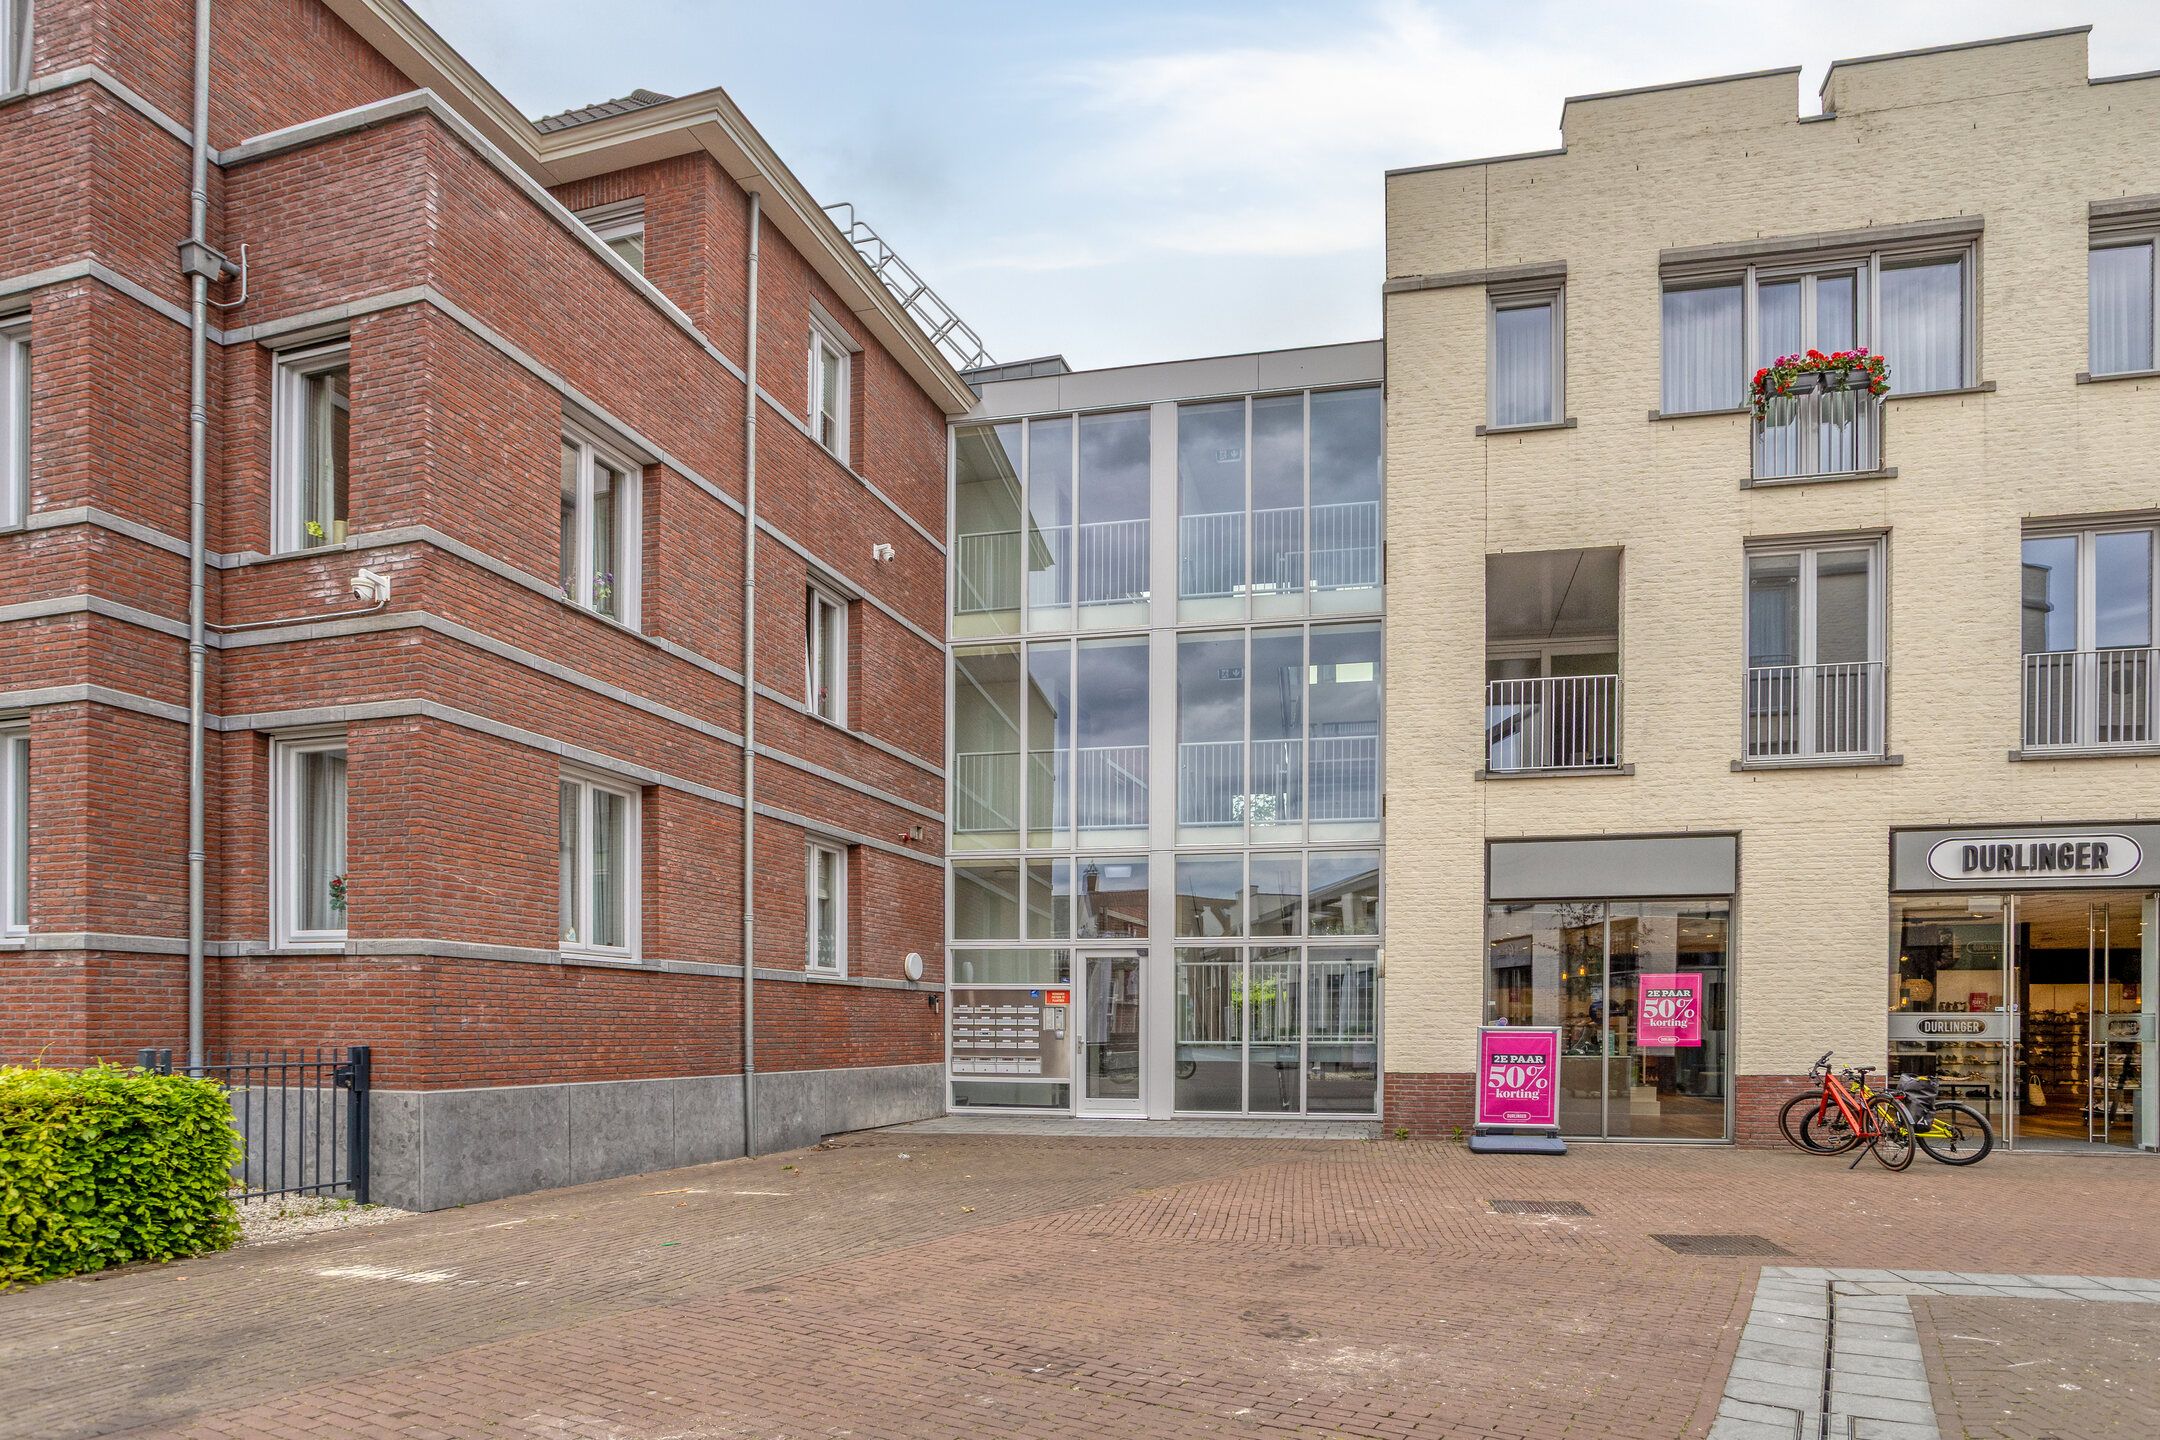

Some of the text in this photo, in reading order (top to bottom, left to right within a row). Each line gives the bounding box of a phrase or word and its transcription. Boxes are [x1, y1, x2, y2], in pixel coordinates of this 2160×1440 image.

[1962, 842, 2109, 872] DURLINGER
[1643, 998, 1695, 1019] 50%
[1650, 1018, 1688, 1028] korting
[1924, 1021, 1979, 1032] DURLINGER
[1493, 1055, 1544, 1064] 2E PAAR
[1488, 1065, 1548, 1090] 50%
[1496, 1088, 1540, 1100] korting
